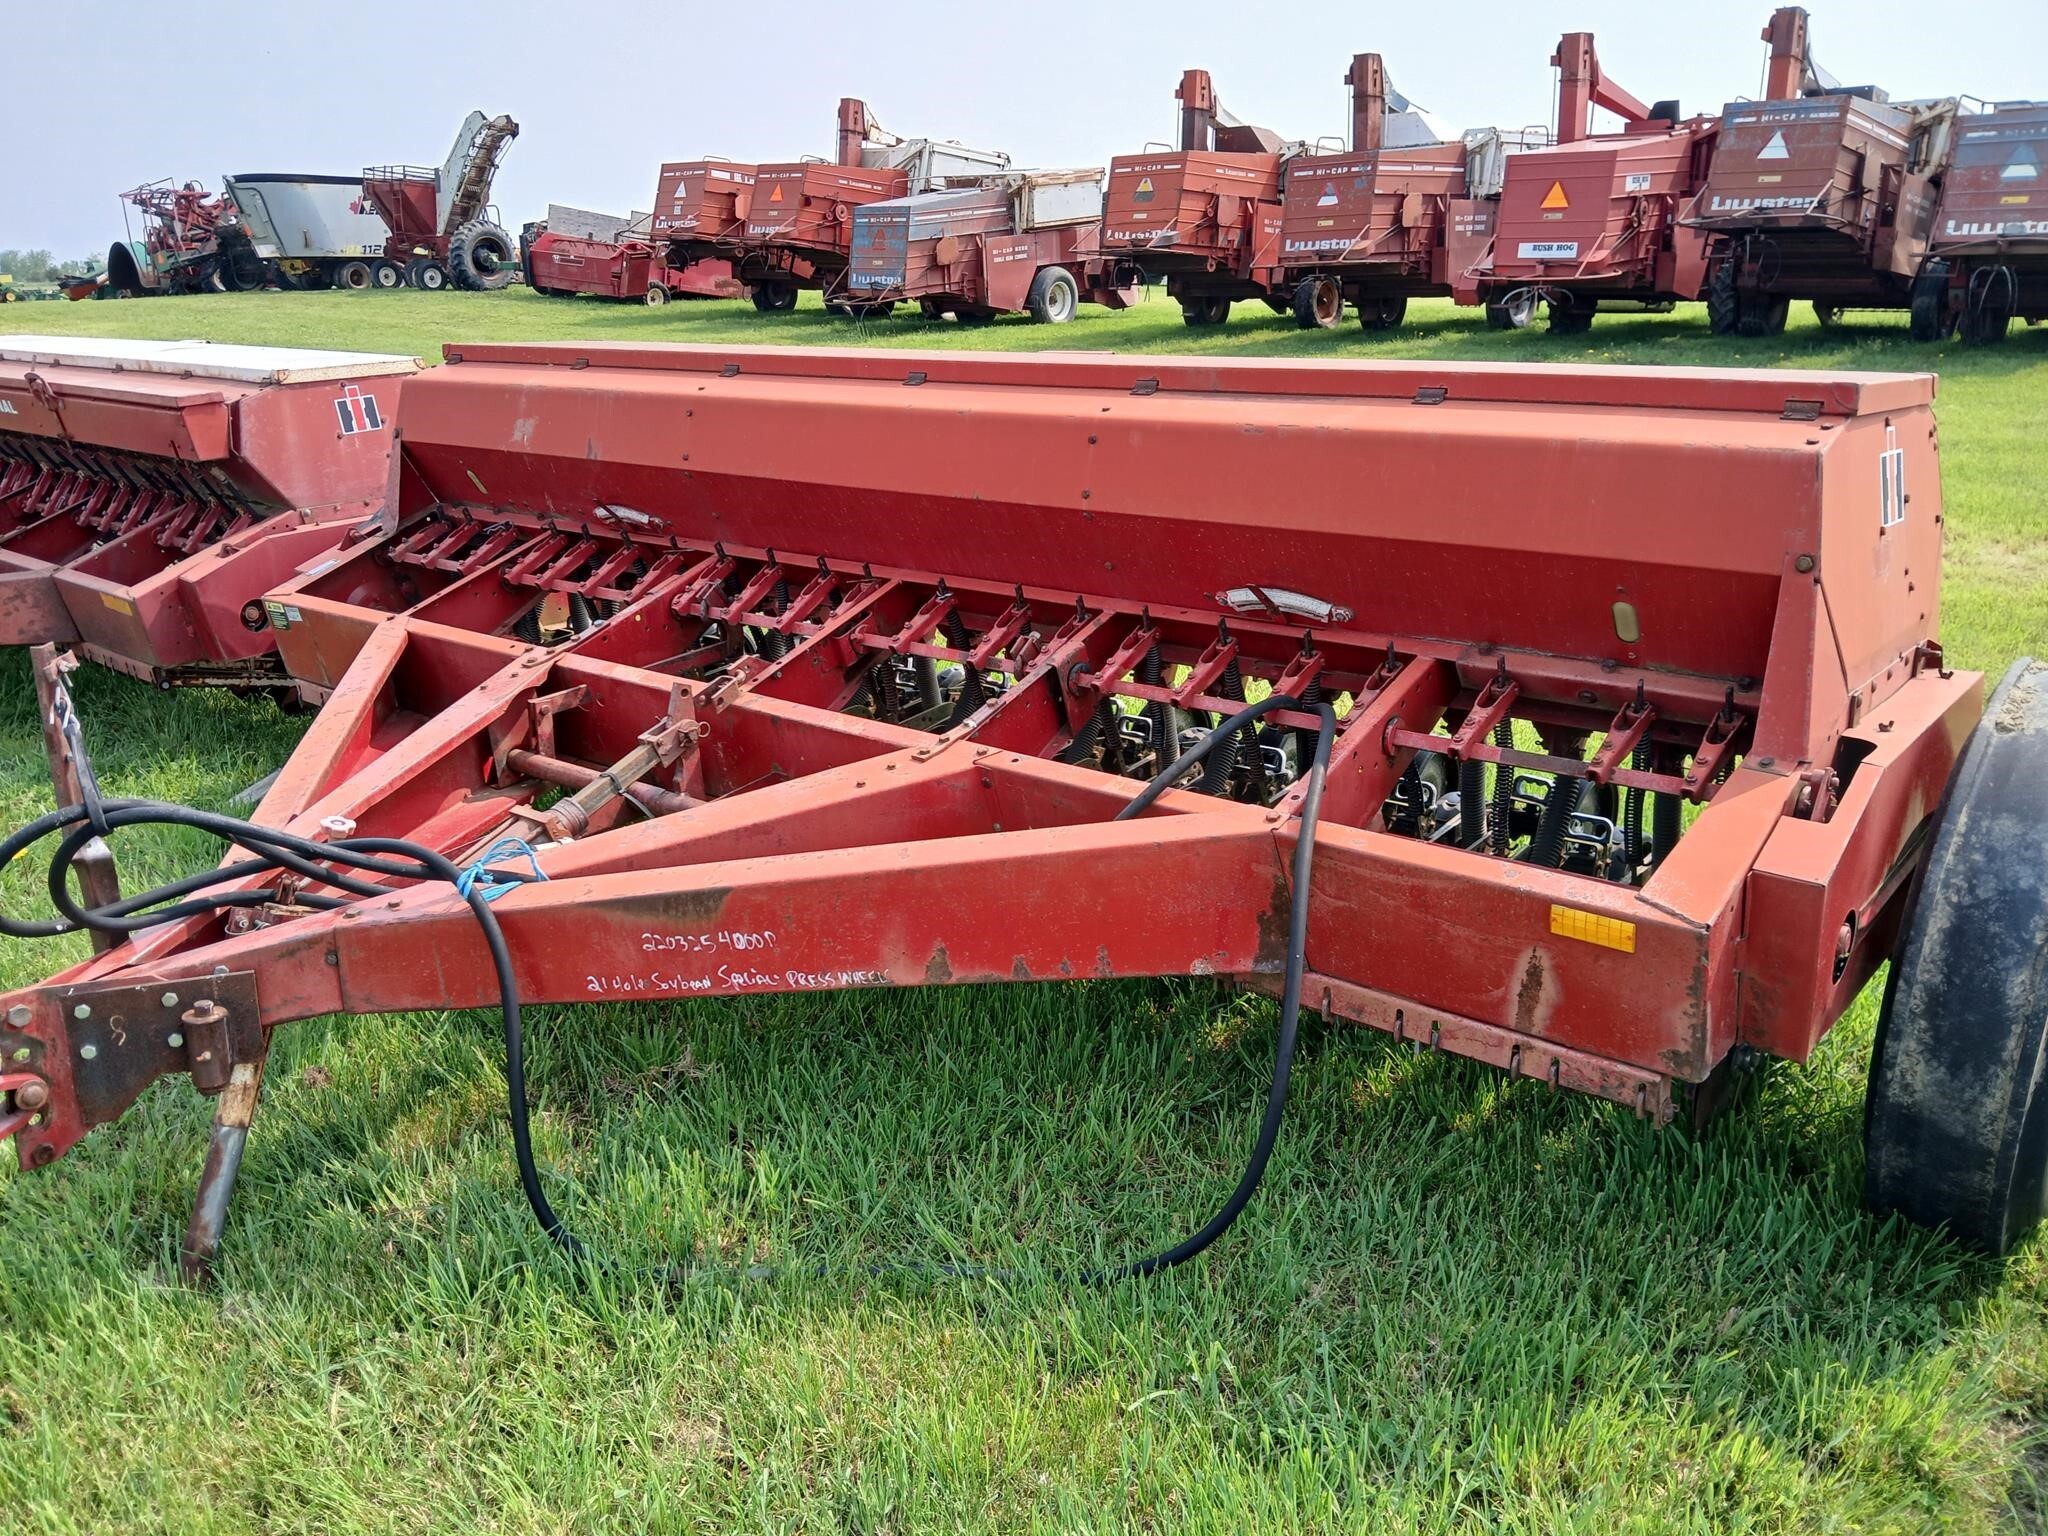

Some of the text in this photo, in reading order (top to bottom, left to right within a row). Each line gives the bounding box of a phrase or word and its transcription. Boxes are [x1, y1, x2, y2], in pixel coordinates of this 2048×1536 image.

[1316, 166, 1349, 176] HI-CAP
[361, 244, 384, 255] 112
[1532, 243, 1575, 252] BUSH HOG
[586, 975, 605, 993] 21
[785, 970, 836, 988] PRESS
